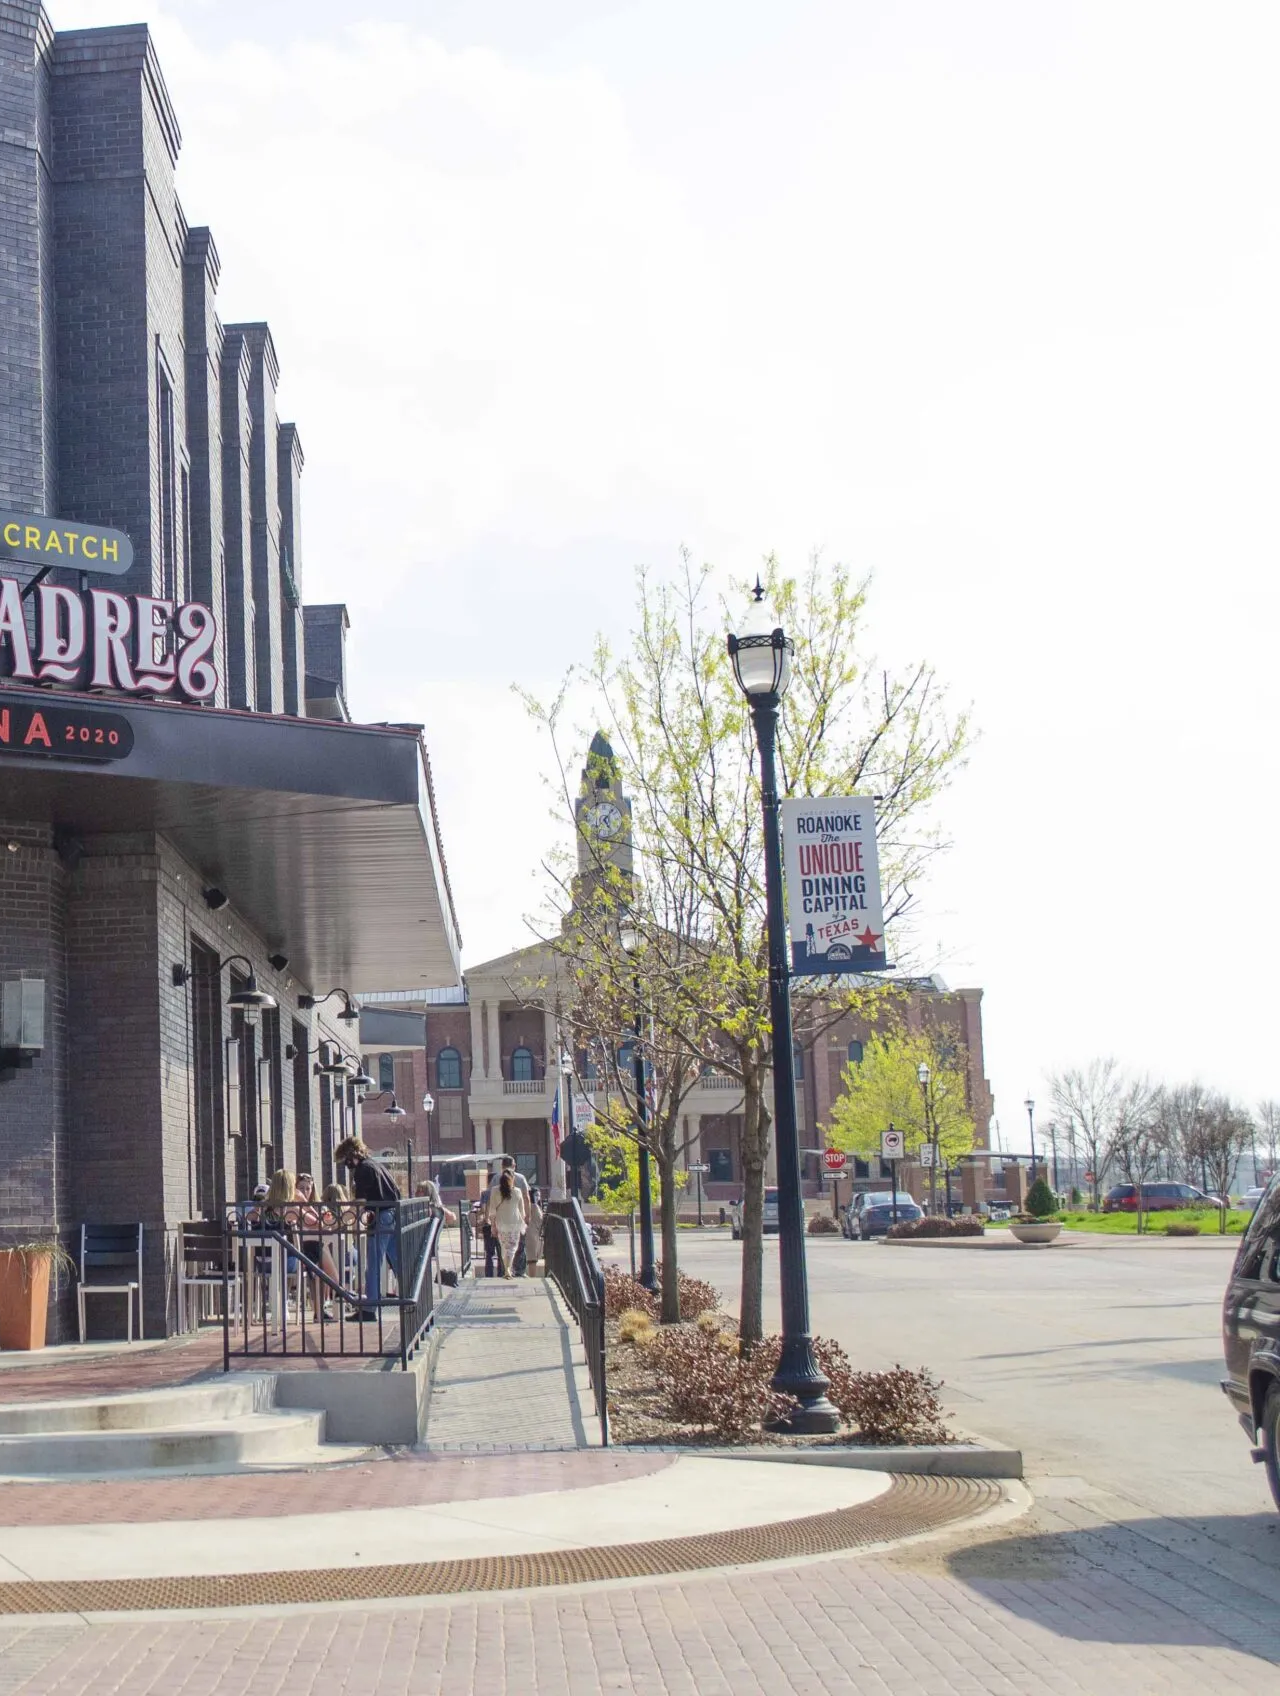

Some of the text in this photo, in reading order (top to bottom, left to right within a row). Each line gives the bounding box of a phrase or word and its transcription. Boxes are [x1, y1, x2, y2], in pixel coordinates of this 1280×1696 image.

[65, 725, 120, 745] 2020
[797, 814, 862, 834] ROANOKE
[821, 833, 840, 843] The
[799, 842, 864, 876] UNIQUE
[802, 875, 866, 898] DINING
[803, 895, 868, 914] CAPITAL
[817, 918, 859, 940] TEXAS
[825, 1153, 845, 1163] STOP
